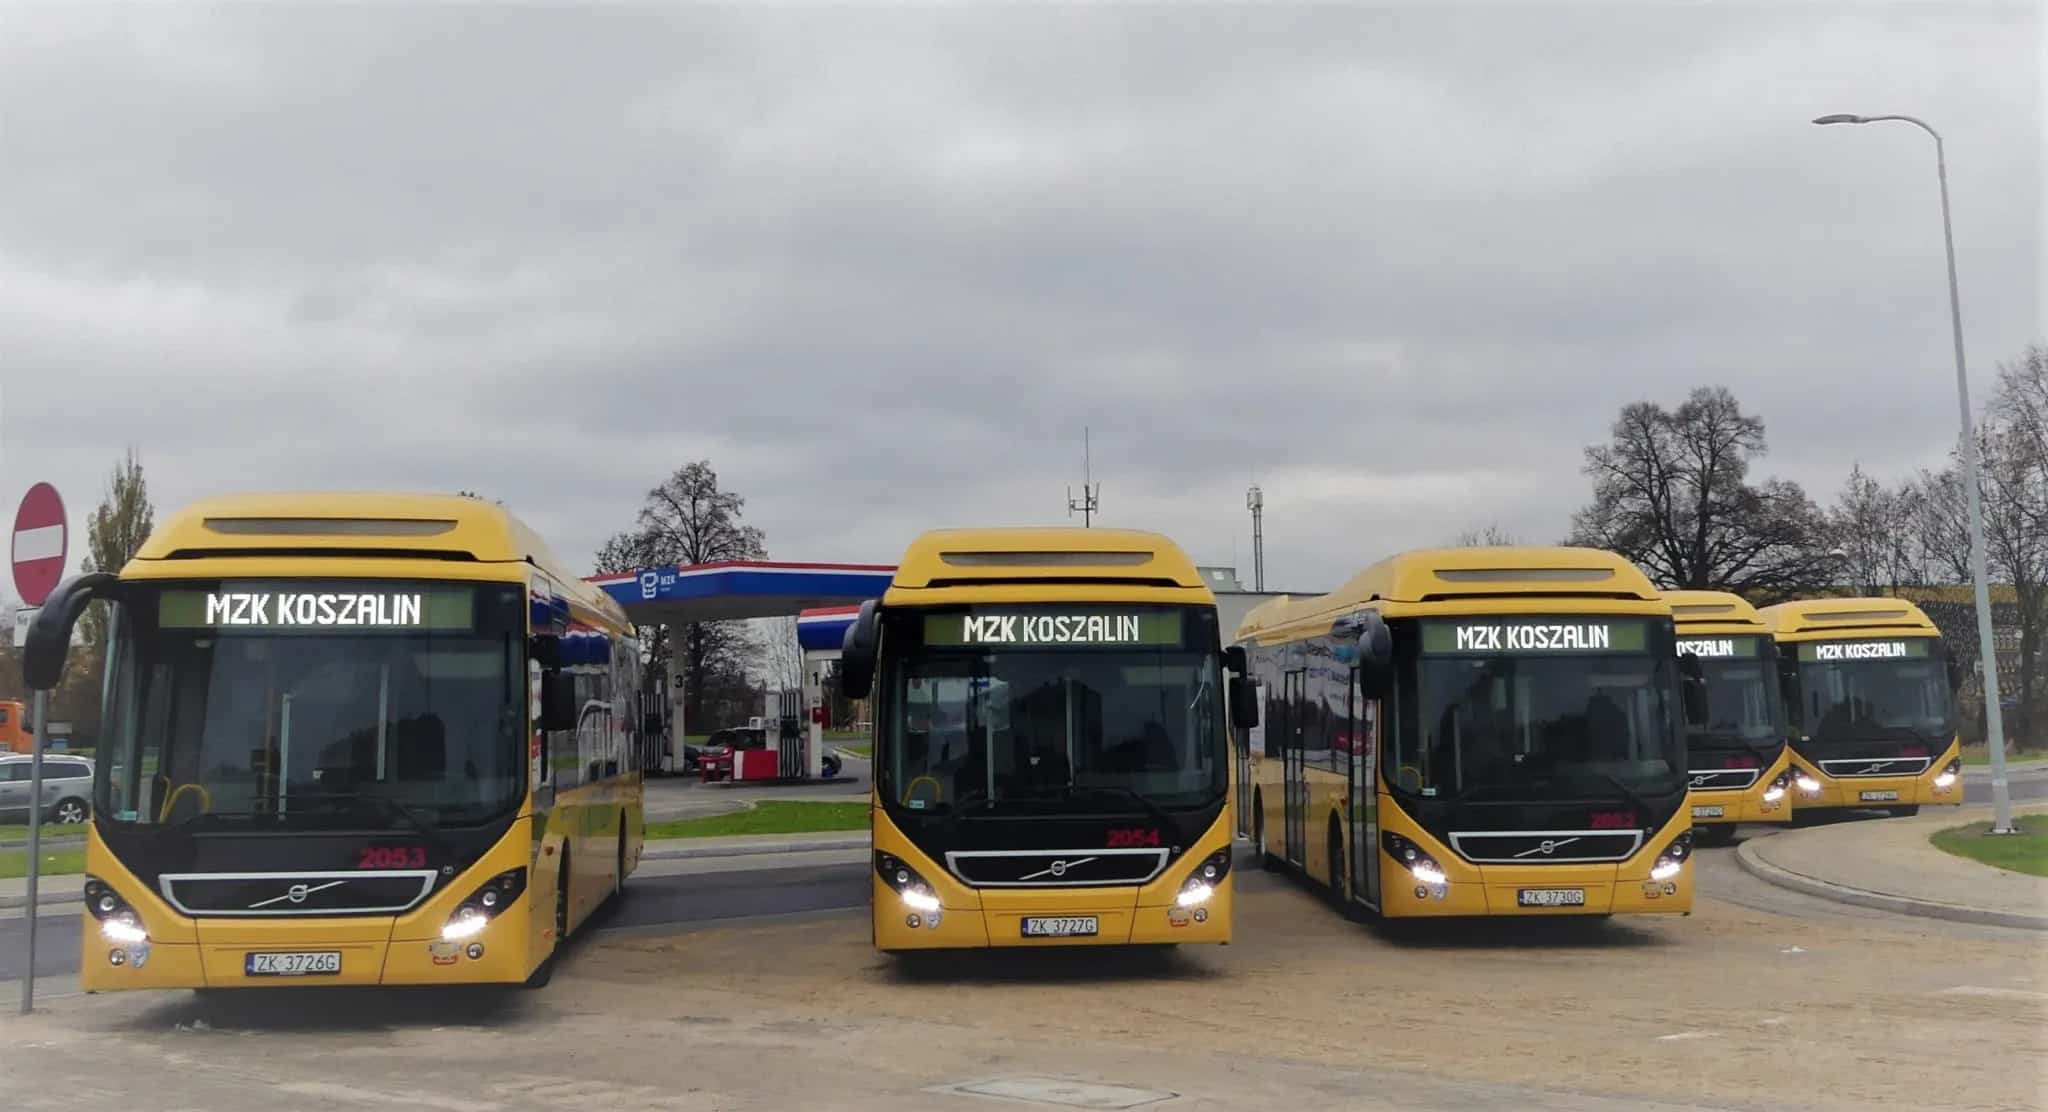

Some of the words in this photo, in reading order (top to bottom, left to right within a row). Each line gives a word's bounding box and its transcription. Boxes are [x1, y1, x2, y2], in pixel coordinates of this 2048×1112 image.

[206, 593, 270, 625] MZK
[277, 593, 421, 625] KOSZALIN
[963, 615, 1017, 643] MZK
[1023, 615, 1139, 642] KOSZALIN
[1456, 625, 1502, 650] MZK
[1506, 624, 1609, 649] KOSZALIN
[1676, 639, 1733, 657] OSZALIN
[1816, 644, 1844, 660] MZK
[1844, 642, 1906, 659] KOSZALIN
[675, 674, 684, 689] 3
[812, 671, 819, 686] 1
[1107, 830, 1160, 848] 2054
[358, 847, 427, 869] 2053
[1526, 891, 1540, 903] ZK
[1031, 919, 1047, 933] ZK
[1053, 919, 1094, 932] 3727G
[257, 955, 279, 971] ZK
[285, 955, 336, 970] 3726G
